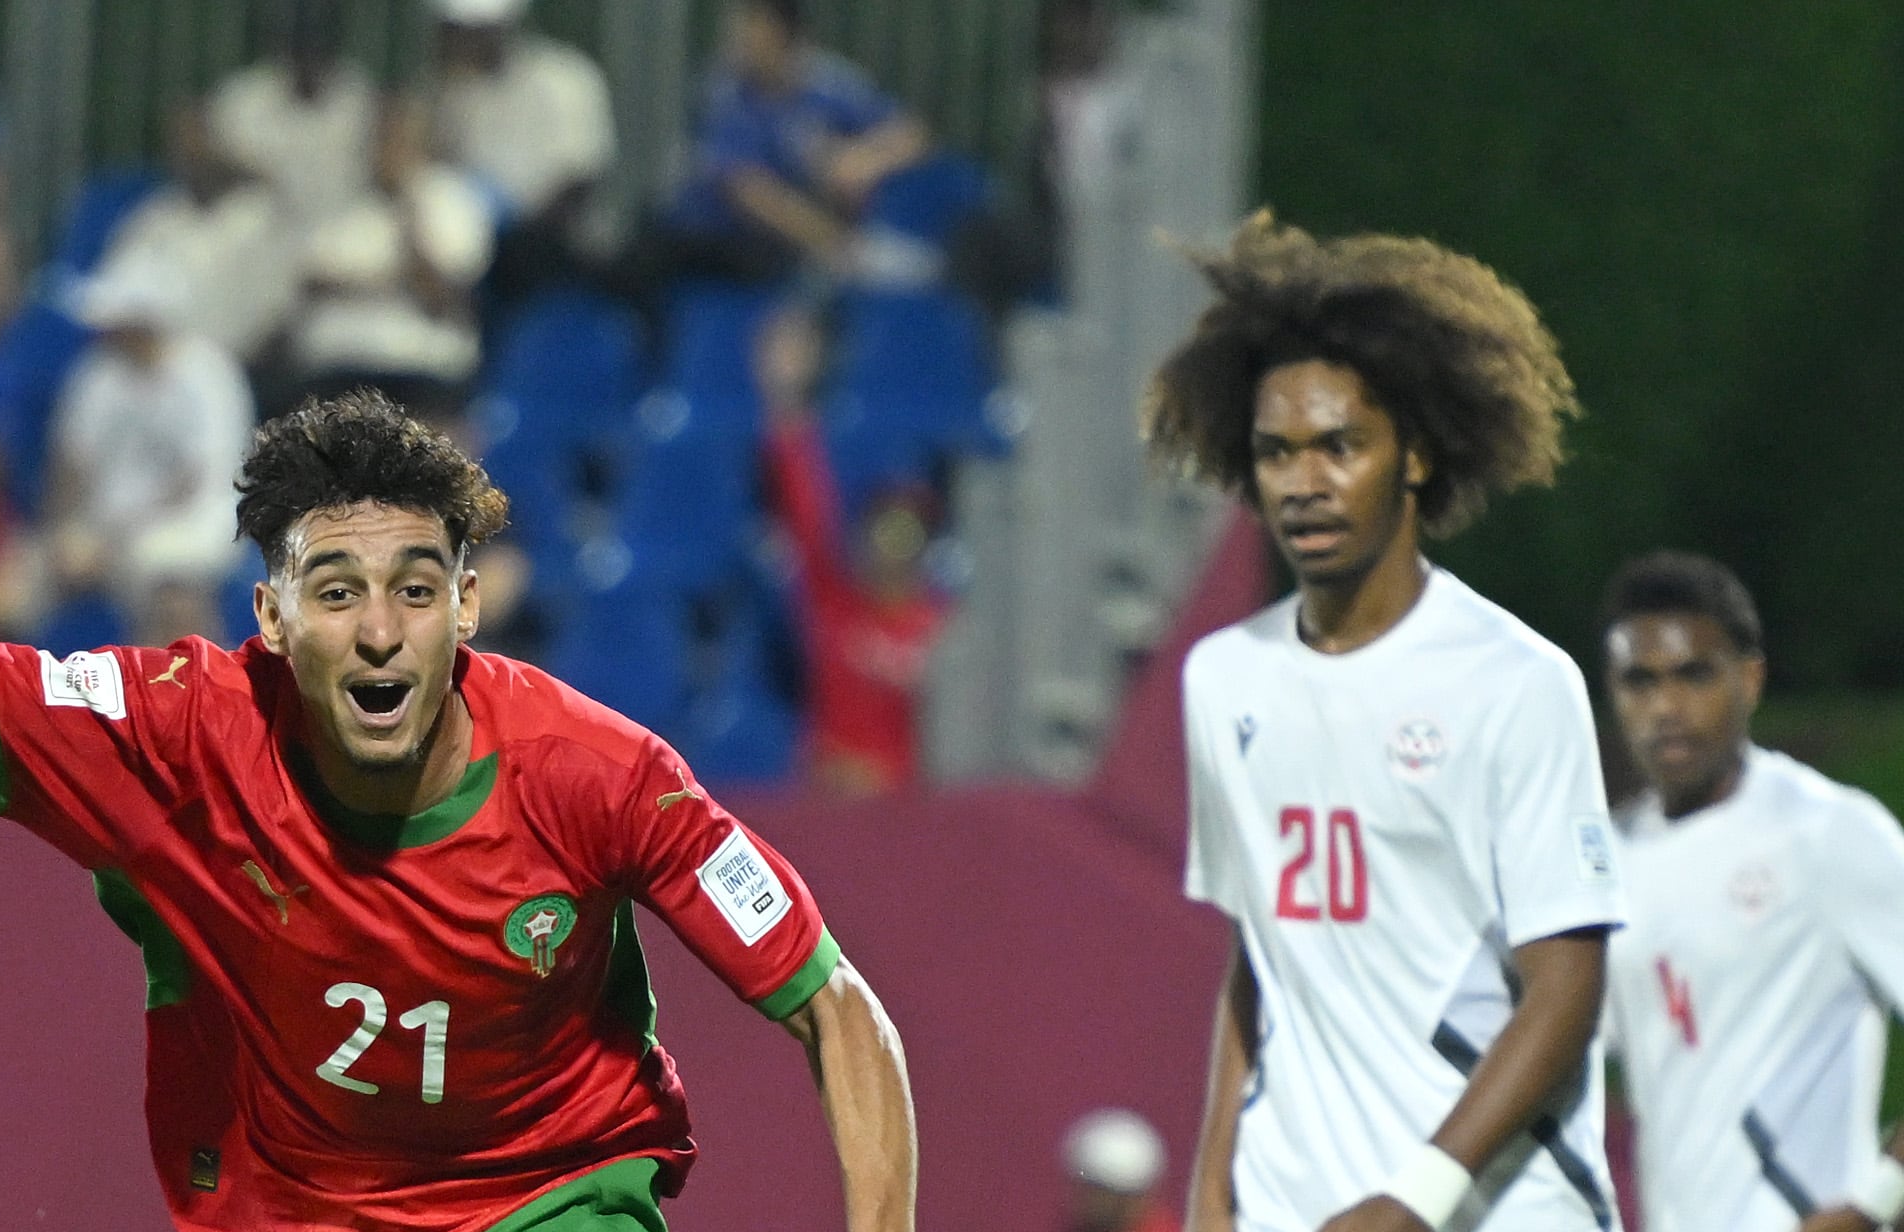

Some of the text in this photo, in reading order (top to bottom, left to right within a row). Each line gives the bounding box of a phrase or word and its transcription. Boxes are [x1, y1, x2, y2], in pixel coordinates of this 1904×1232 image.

[1276, 806, 1369, 923] 20
[315, 981, 451, 1105] 21
[1653, 953, 1700, 1048] 4
